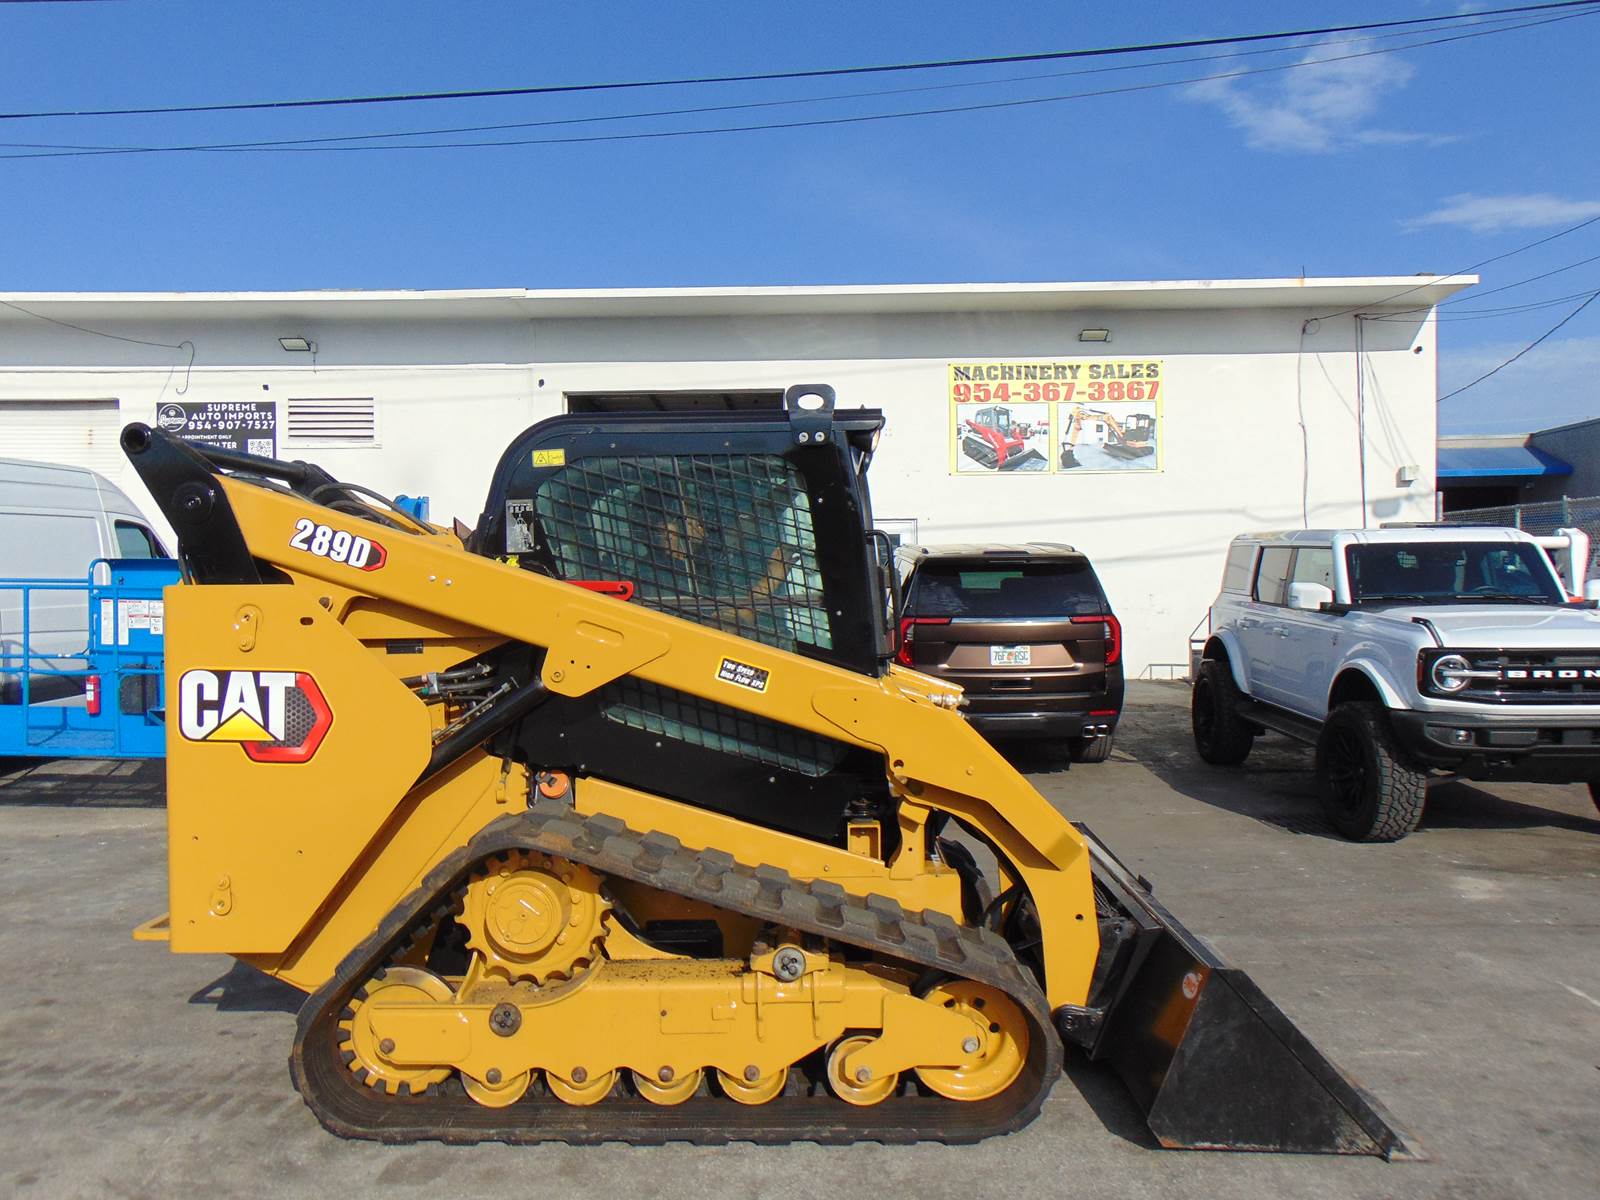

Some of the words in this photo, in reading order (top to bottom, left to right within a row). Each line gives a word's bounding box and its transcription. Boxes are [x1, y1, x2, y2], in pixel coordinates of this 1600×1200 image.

[953, 364, 1081, 381] MACHINERY
[1088, 362, 1159, 380] SALES
[953, 381, 1160, 402] 954-367-3867
[191, 412, 221, 420] AUTO
[224, 412, 273, 420] IMPORTS
[207, 403, 257, 411] SUPREME
[188, 420, 276, 430] 954-907-7527
[290, 518, 371, 568] 289D
[181, 669, 296, 741] CAT
